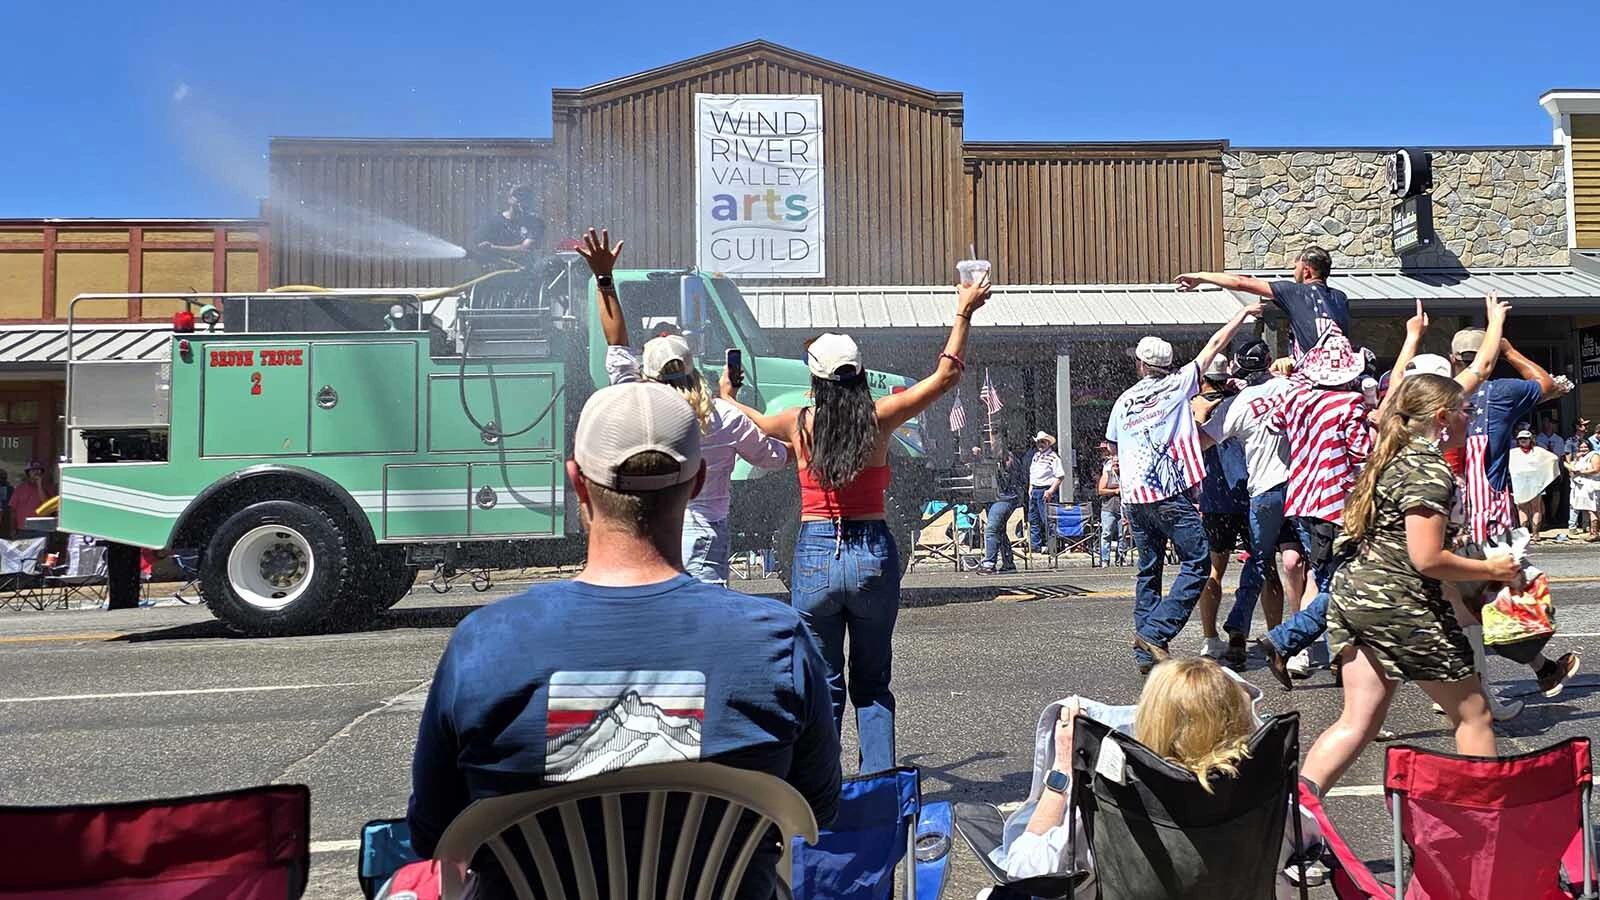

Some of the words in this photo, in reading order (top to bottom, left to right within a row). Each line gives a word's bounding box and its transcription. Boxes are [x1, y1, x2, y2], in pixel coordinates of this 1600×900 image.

[710, 110, 807, 135] WIND
[711, 138, 809, 163] RIVER
[711, 167, 808, 185] VALLEY
[711, 189, 809, 222] arts
[710, 238, 810, 261] GUILD
[210, 350, 254, 367] BRUSH
[260, 350, 303, 366] TRUCK
[251, 372, 262, 395] 2
[865, 372, 887, 389] LK
[2, 437, 19, 449] 116
